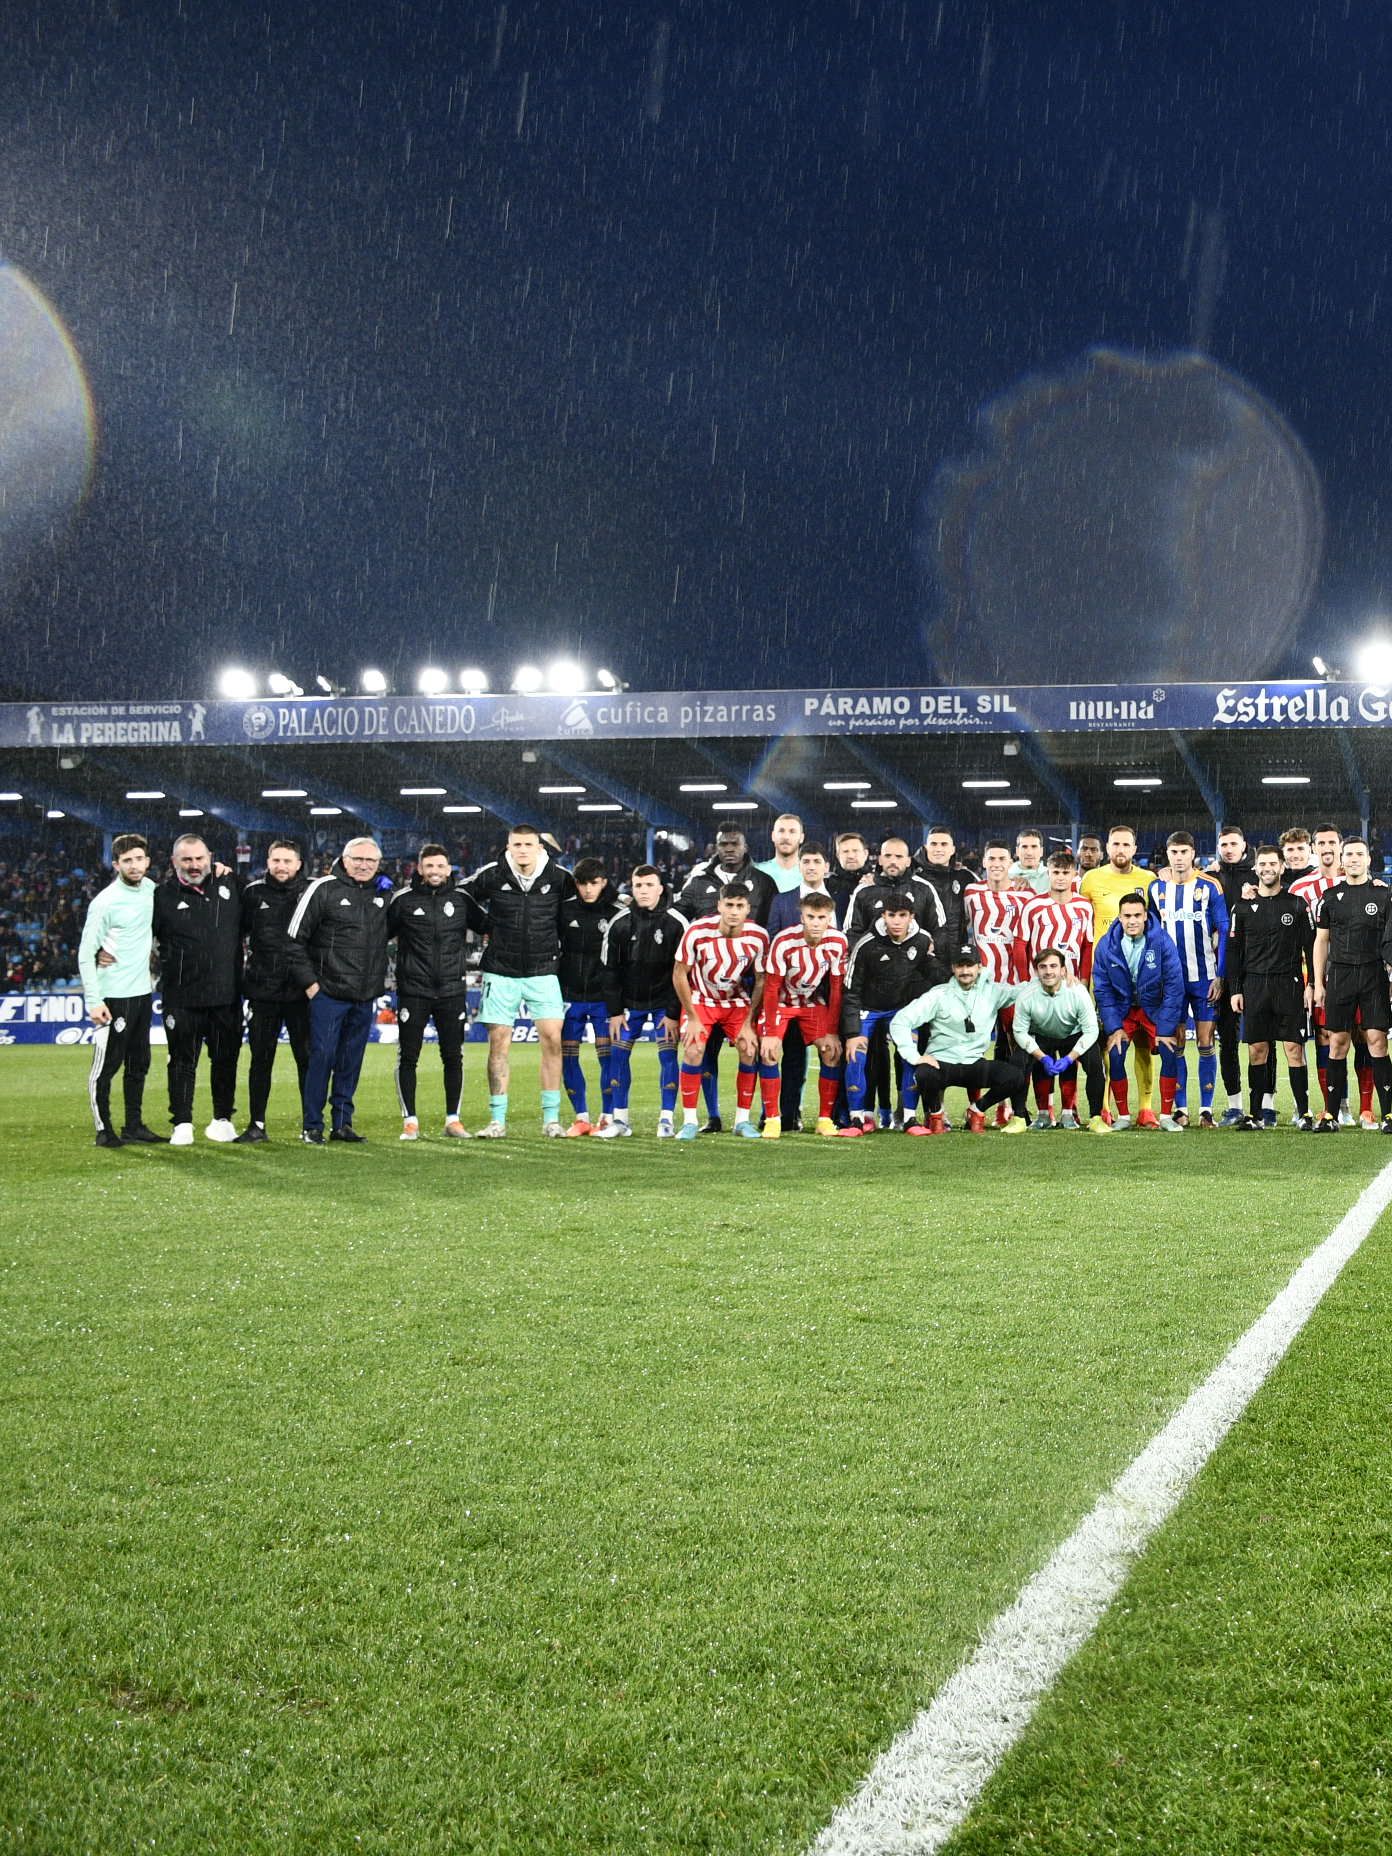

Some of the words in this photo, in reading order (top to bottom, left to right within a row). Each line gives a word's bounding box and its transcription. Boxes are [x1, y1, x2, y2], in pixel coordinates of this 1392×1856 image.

[112, 705, 127, 716] DE
[129, 704, 182, 715] SERVICIO
[597, 702, 669, 725] cufica
[680, 700, 777, 728] pizarras
[804, 694, 910, 716] PÁRAMO
[920, 696, 968, 714] DEL
[976, 695, 1017, 713] SIL
[1212, 688, 1351, 724] Estrella
[52, 723, 76, 744] LA
[80, 721, 182, 743] PEREGRINA
[278, 706, 359, 737] PALACIO
[363, 707, 389, 735] DE
[394, 704, 476, 735] CANEDO
